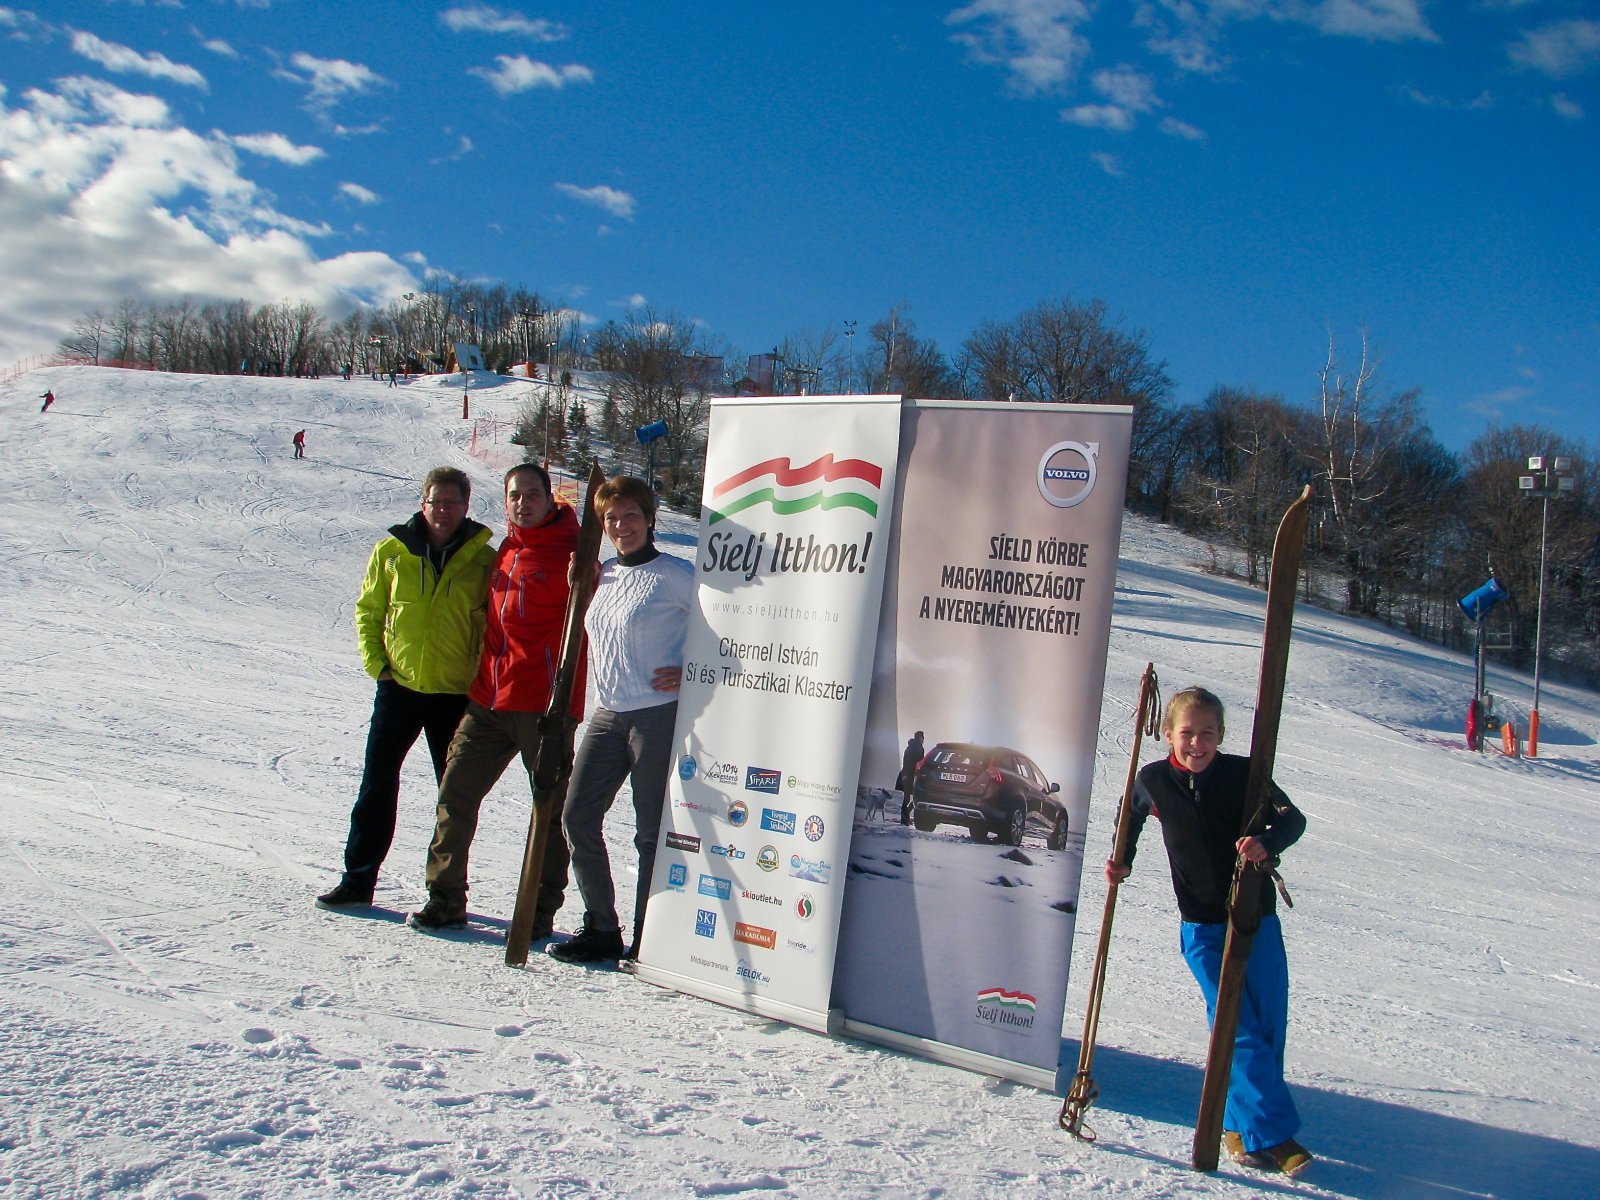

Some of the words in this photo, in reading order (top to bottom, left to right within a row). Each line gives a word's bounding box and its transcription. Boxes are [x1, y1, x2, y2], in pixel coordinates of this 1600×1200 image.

[1046, 469, 1087, 480] VOLVO
[703, 532, 767, 581] Síelj
[770, 532, 873, 574] Itthon!
[989, 533, 1032, 562] SÍELD
[1036, 537, 1089, 568] KÖRBE
[941, 565, 1086, 601] MAGYARORSZÁGOT
[712, 602, 839, 624] www.sieljitthon.hu
[919, 596, 930, 619] A
[934, 598, 1080, 636] NYEREMÉNYEKÉRT!
[719, 637, 774, 663] Chernel
[777, 642, 819, 668] István
[686, 662, 698, 681] Sí
[700, 664, 716, 685] és
[721, 666, 791, 695] Turisztikai
[794, 675, 853, 702] Klaszter
[742, 890, 783, 906] skioutlet.hu
[697, 911, 715, 925] SKI
[976, 1005, 998, 1024] Síelj
[1000, 1010, 1034, 1029] Itthon!
